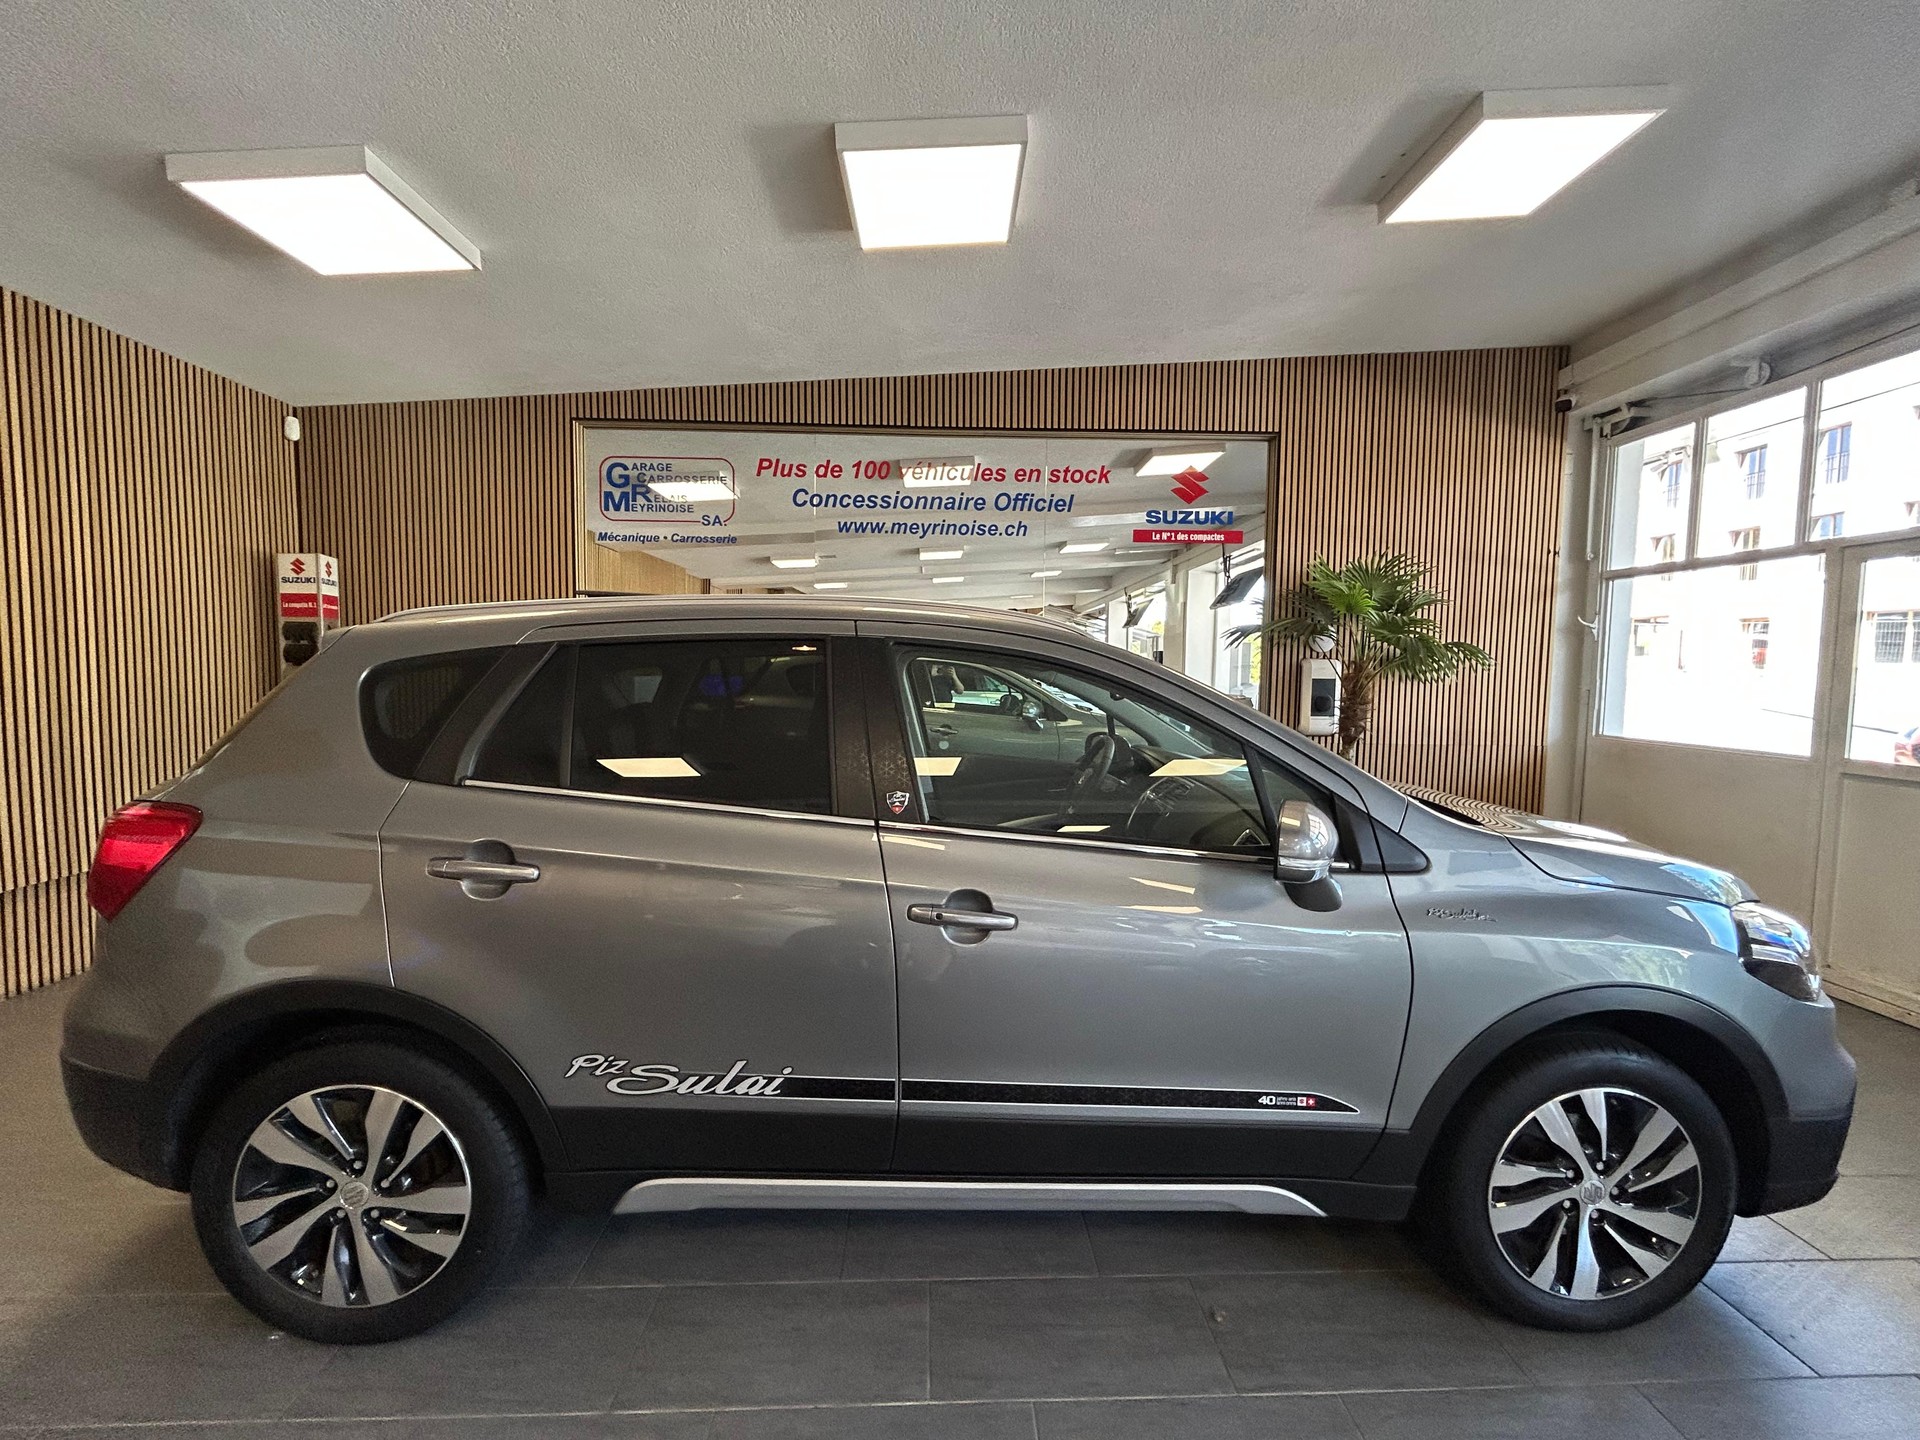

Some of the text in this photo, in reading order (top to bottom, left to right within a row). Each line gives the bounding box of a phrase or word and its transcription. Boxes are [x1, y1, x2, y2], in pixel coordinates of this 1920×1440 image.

[606, 462, 673, 488] GARAGE
[636, 472, 728, 485] CARROSSERIE
[756, 458, 1111, 484] Plus de 100 véhicules en stock
[603, 491, 695, 512] MEYRINOISE
[792, 488, 1074, 513] Concessionnaire Officiel
[1145, 510, 1234, 525] SUZUKI
[597, 532, 738, 544] Mécanique Carrosserie
[837, 520, 1028, 539] www.meyrinoise.ch
[1152, 532, 1160, 540] Le
[1176, 532, 1188, 541] des
[1189, 533, 1225, 542] compactes
[281, 576, 316, 584] SUZUKI
[564, 1054, 793, 1096] Piz Sulai
[1257, 1095, 1276, 1106] 40
